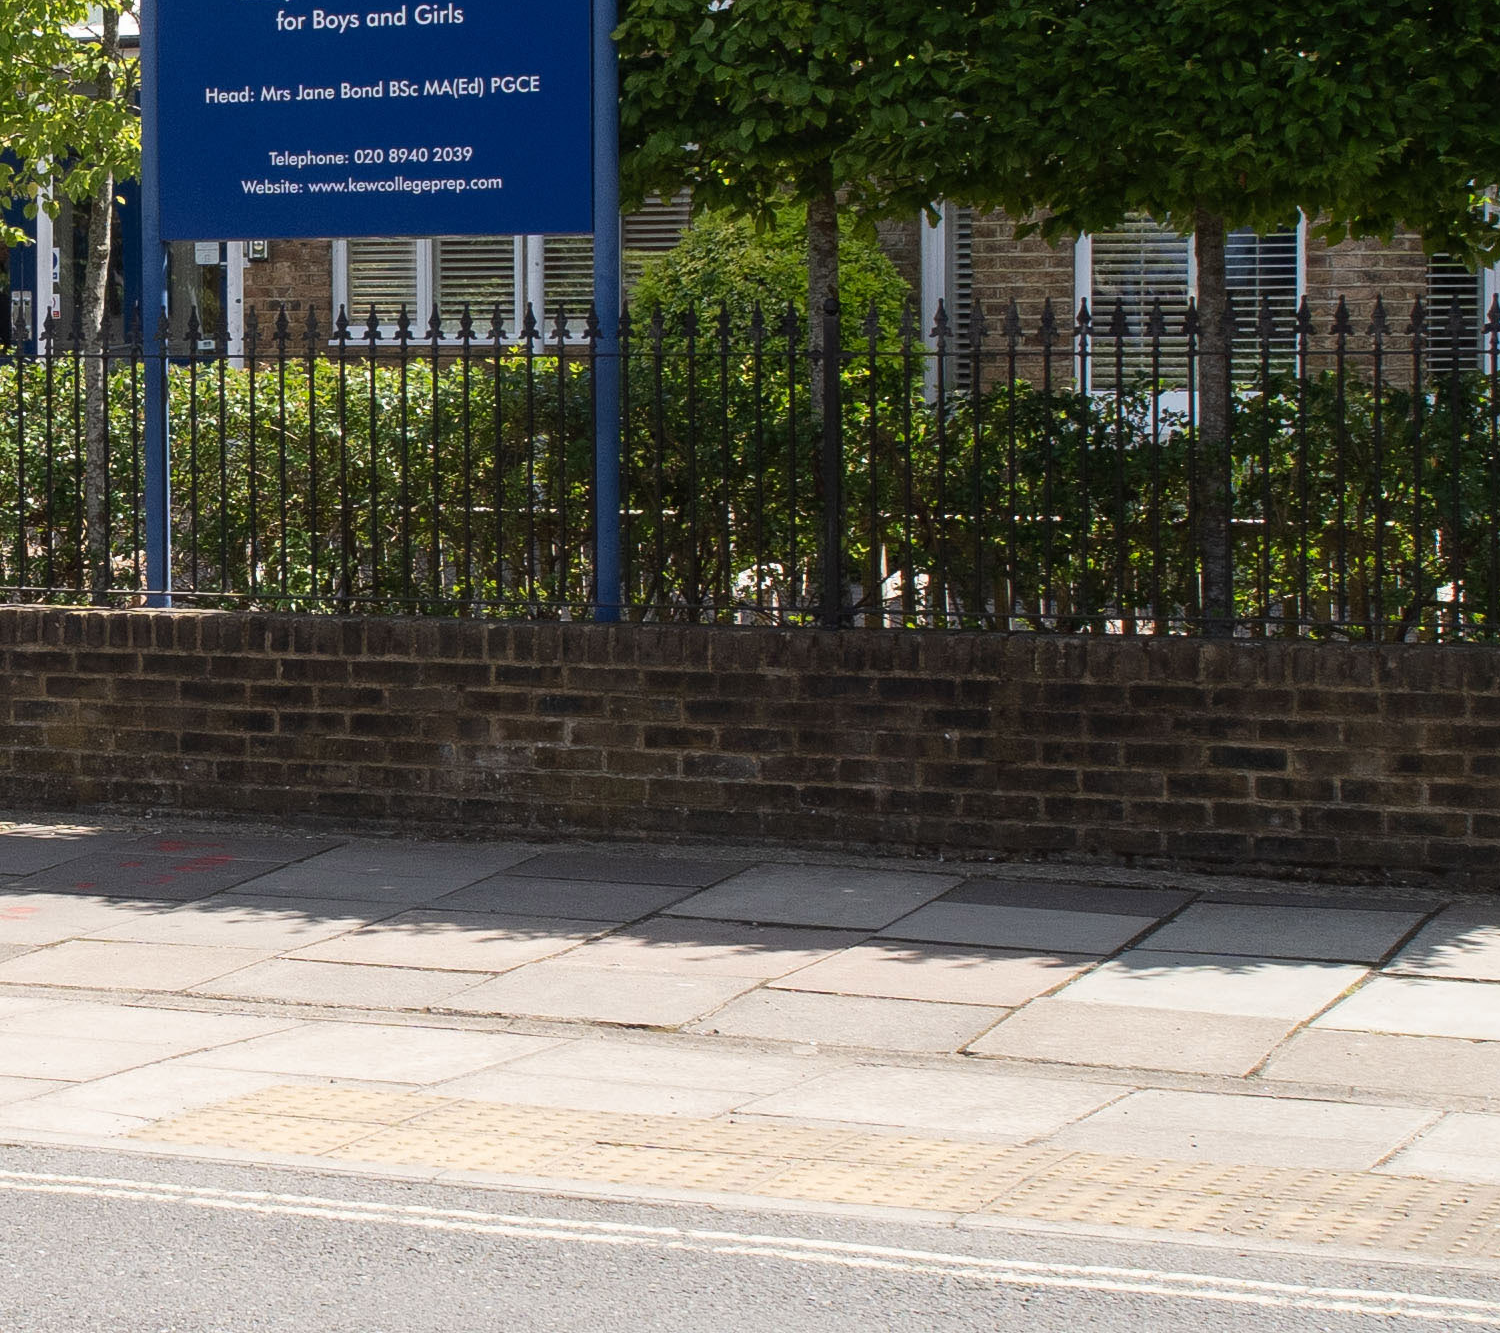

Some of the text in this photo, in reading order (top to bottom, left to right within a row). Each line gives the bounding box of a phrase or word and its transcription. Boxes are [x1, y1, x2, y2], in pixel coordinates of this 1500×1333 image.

[275, 2, 464, 34] for Boys and Girls
[205, 75, 540, 104] Head: Mrs Jane Bond BSc MA(Ed) PGCE
[268, 146, 473, 169] Telephone: 020 8940 2039
[241, 176, 503, 195] Website: www.kewcollegeprep.com
